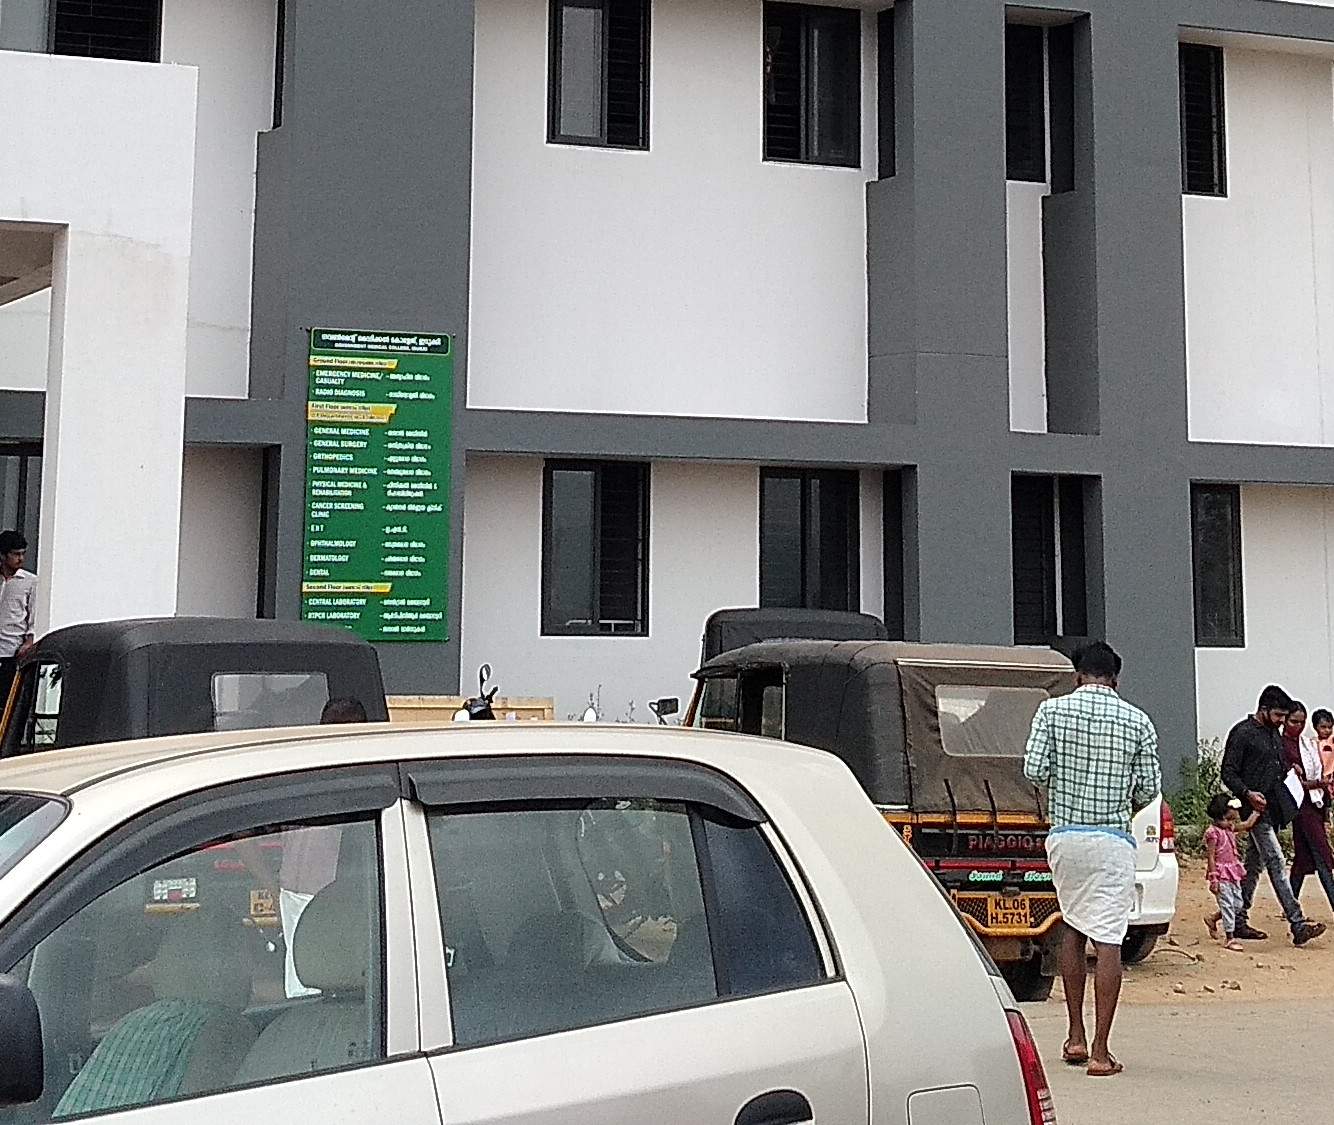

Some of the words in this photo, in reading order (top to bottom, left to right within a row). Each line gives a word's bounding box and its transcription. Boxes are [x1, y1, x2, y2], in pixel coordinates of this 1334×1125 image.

[316, 370, 351, 378] EMERGENCY
[334, 389, 366, 397] DIAGNOSIS
[314, 427, 340, 435] GENERAL
[341, 428, 370, 436] MEDICINE
[313, 453, 354, 461] ORTHOPEDICS
[312, 466, 348, 474] PULMONARY
[349, 467, 378, 475] MEDICINE
[312, 480, 337, 488] PHYSICAL
[334, 502, 364, 510] SCREENING
[308, 598, 333, 606] CENTRAL
[333, 598, 367, 606] LABORATORY
[968, 835, 1033, 851] PIAGGIO
[968, 870, 1003, 882] Sound
[994, 898, 1027, 911] KL.06
[990, 912, 1028, 925] H.5731
